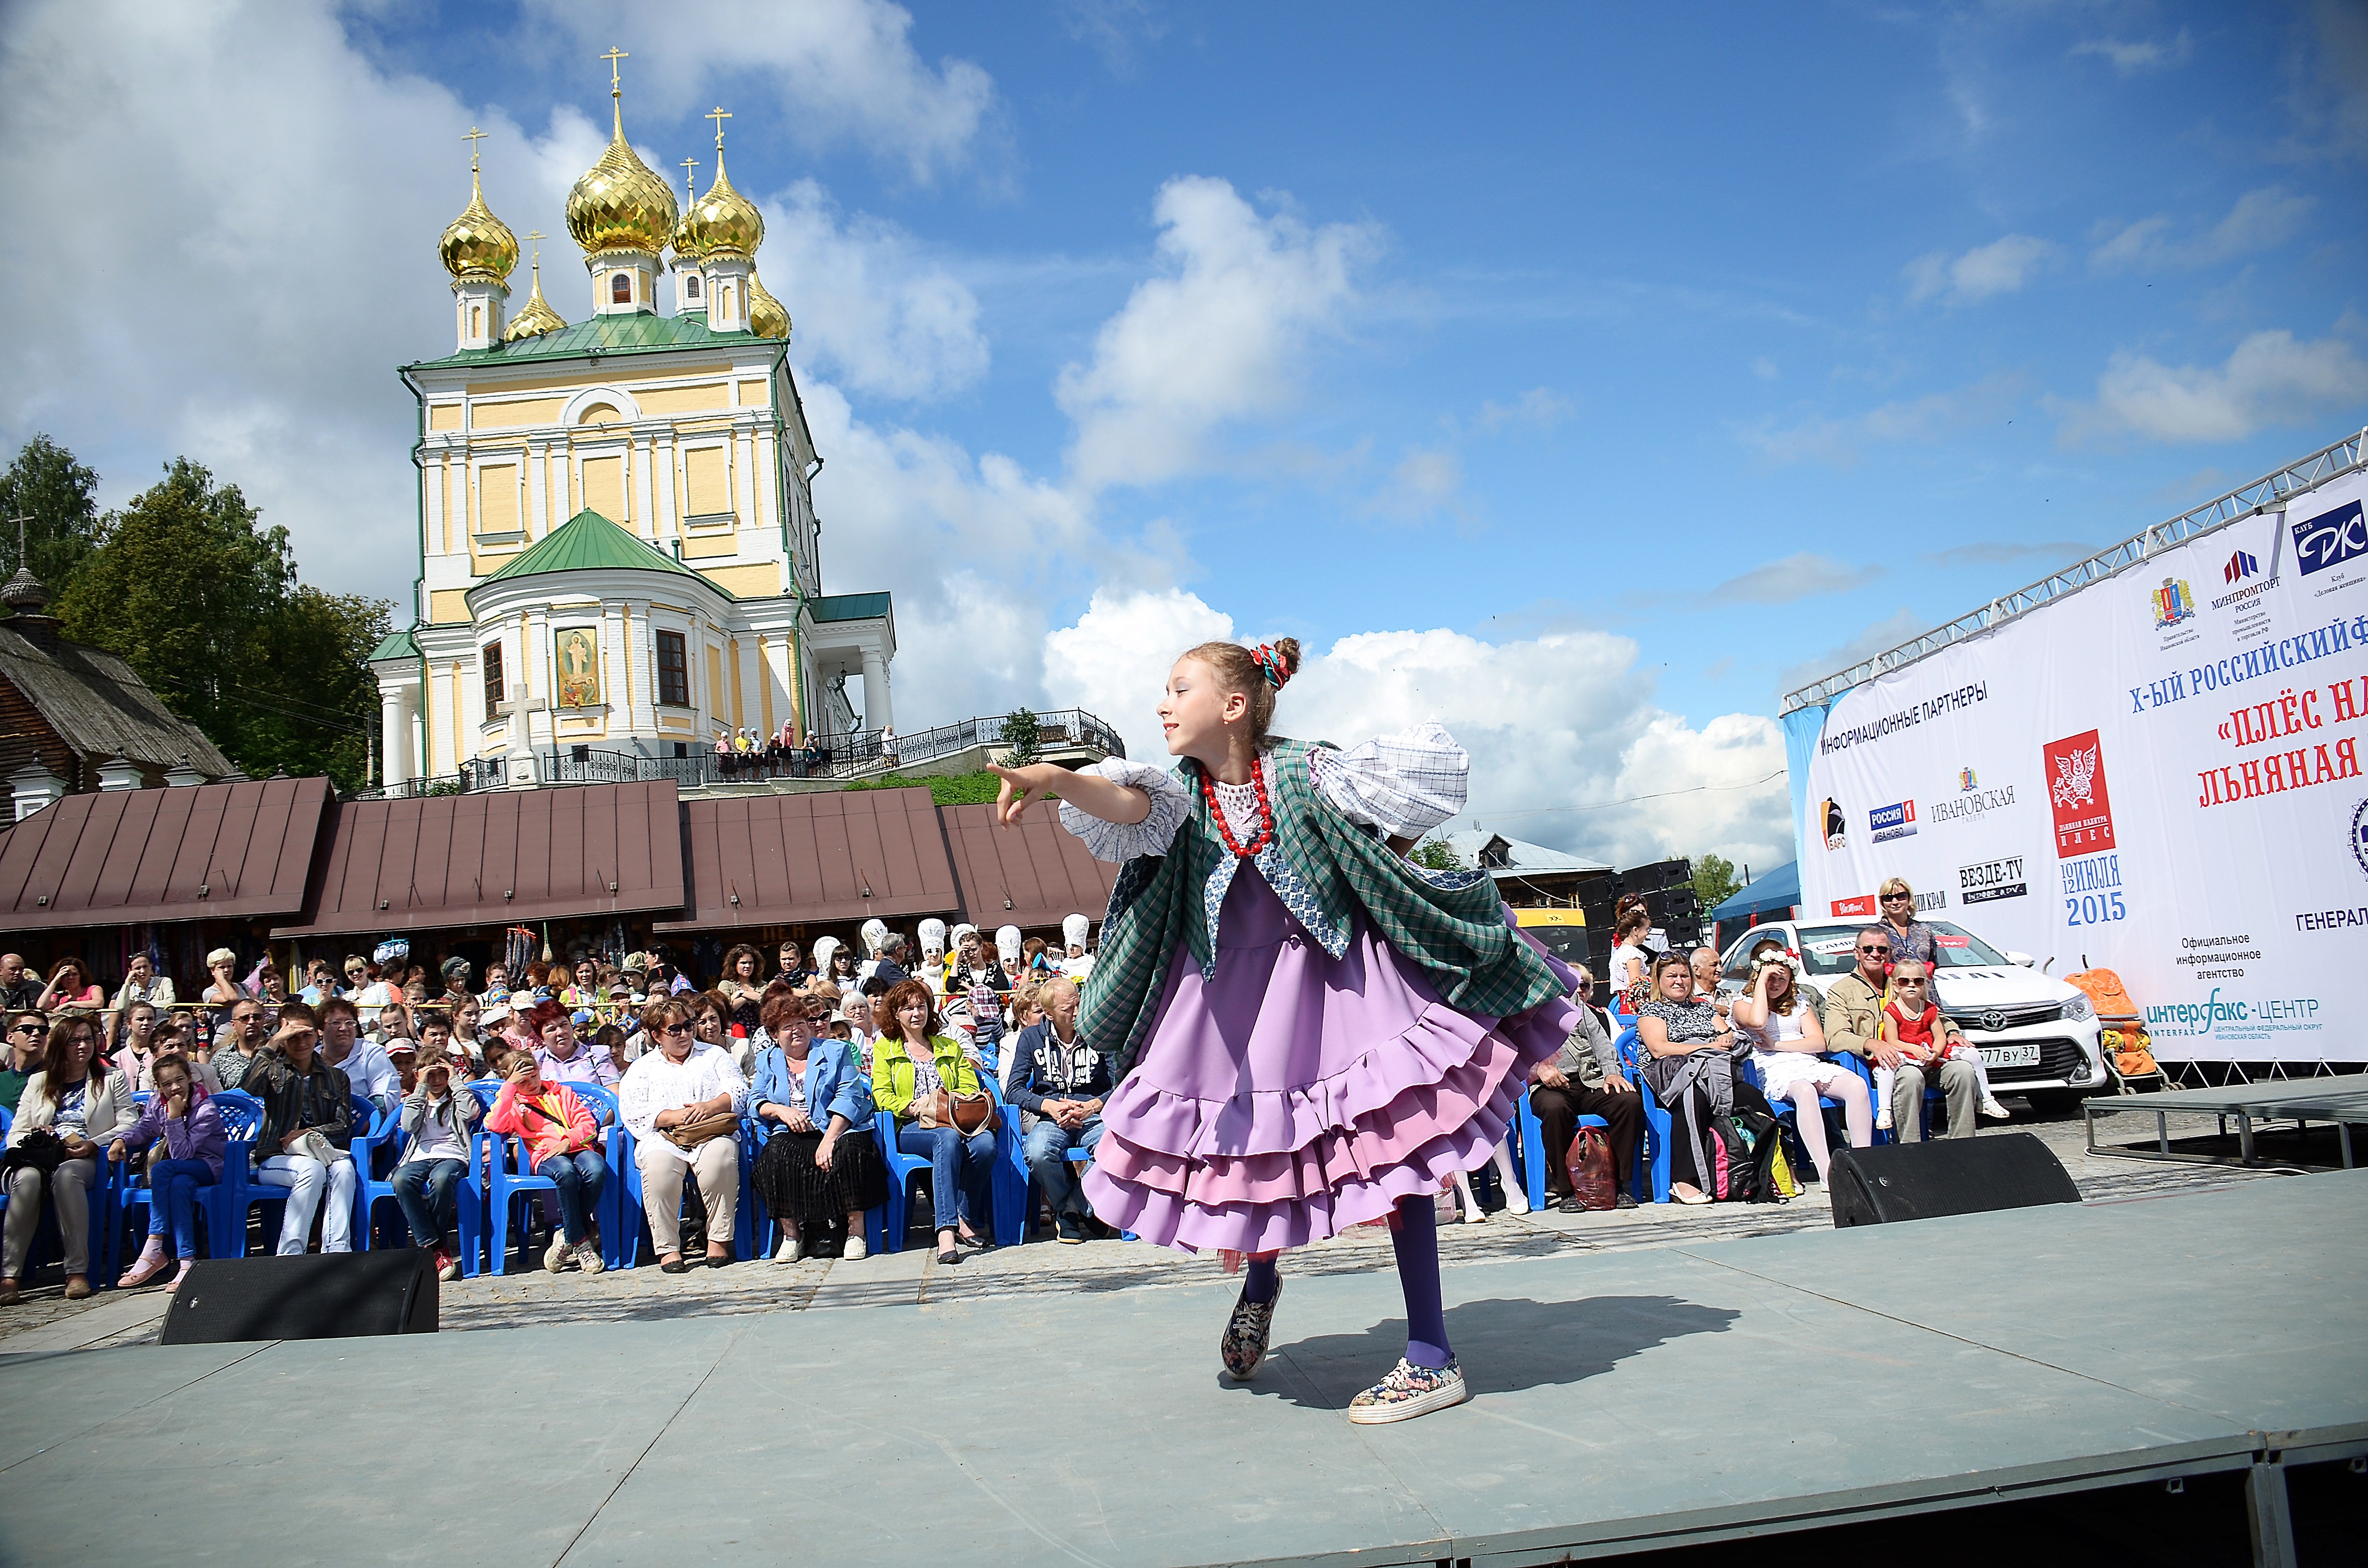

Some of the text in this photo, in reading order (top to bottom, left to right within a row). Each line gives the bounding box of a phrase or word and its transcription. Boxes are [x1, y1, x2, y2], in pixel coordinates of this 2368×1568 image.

[2294, 522, 2313, 535] КЛУБ
[2331, 573, 2344, 583] Клуб
[2211, 576, 2280, 610] МИНПРОМТОРГ
[2235, 598, 2261, 613] РОССИЯ
[2234, 611, 2266, 625] Министерство
[2261, 626, 2269, 635] РФ
[2189, 617, 2352, 696] РОССИЙСКИЙ
[1821, 680, 1987, 756] ИНФОРМАЦИОННЫЕ ПАРТНЕРЫ
[2218, 688, 2322, 747] «ПЛЁС
[2198, 737, 2363, 808] ЛЬНЯНАЯ
[1931, 785, 2016, 823] ИВАНОВСКАЯ
[1871, 808, 1902, 825] РОССИЯ
[1874, 827, 1904, 841] ИВАНОВО
[1829, 837, 1846, 851] БАРС
[1960, 858, 2023, 888] ВЕЗДЕ-TV
[2060, 863, 2073, 879] 10
[2062, 855, 2122, 894] 12 ИЮЛЯ
[2066, 891, 2126, 926] 2015
[2182, 934, 2250, 950] Официальное
[2176, 950, 2261, 967] информационное
[2197, 968, 2244, 980] агентство
[2150, 1029, 2195, 1037] INTERFAX
[2214, 1024, 2255, 1032] ЦЕНТРАЛЬНЫЙ
[2257, 1023, 2302, 1031] ФЕДЕРАЛЬНЫЙ
[1978, 1047, 2035, 1063] 577ВУ 37
